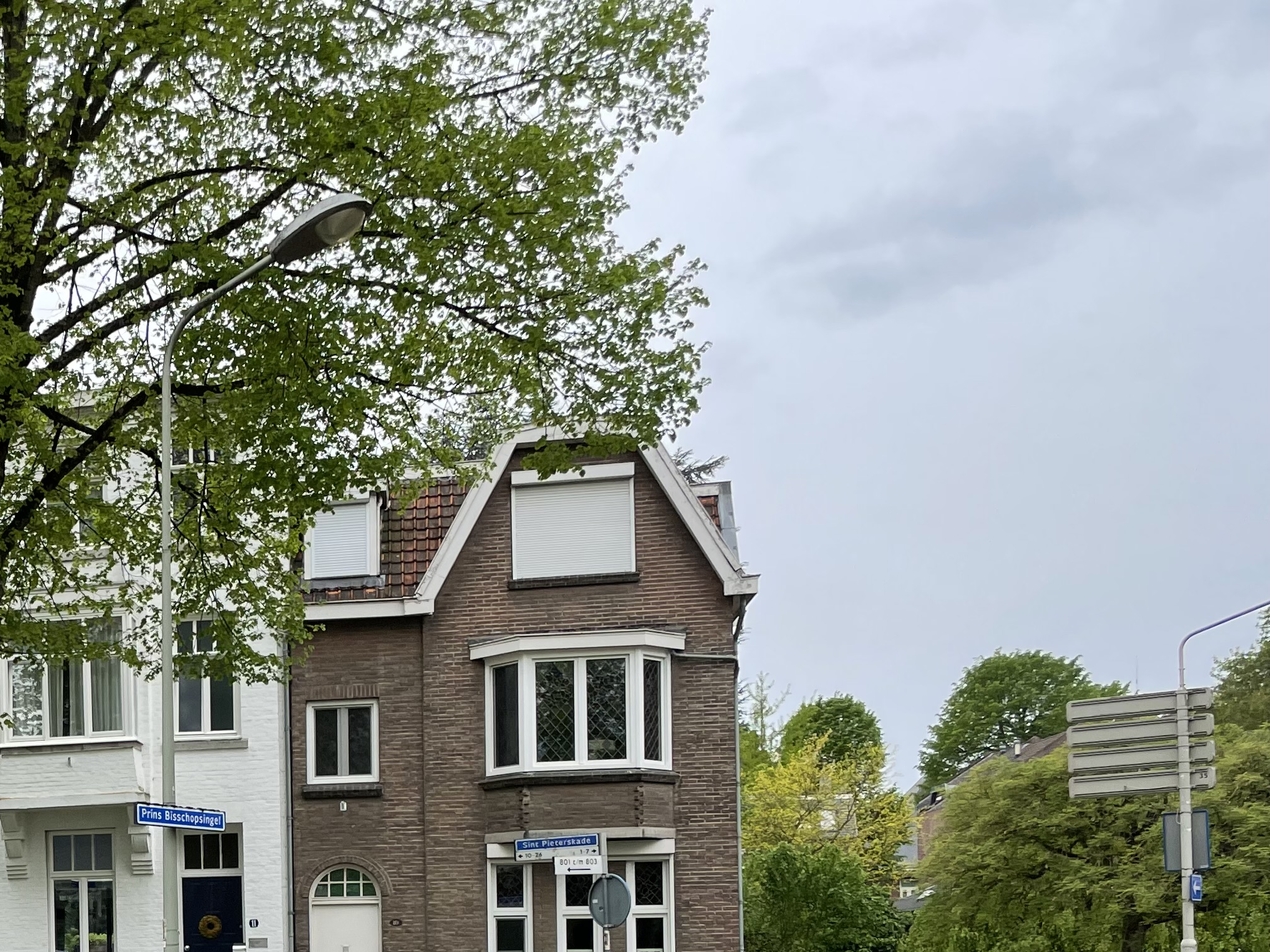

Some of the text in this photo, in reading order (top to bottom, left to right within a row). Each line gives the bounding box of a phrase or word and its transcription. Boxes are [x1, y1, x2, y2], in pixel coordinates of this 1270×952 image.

[141, 808, 222, 826] Prins Bisschopsingel
[522, 837, 591, 849] Sint Pieterskade
[559, 858, 571, 866] 801
